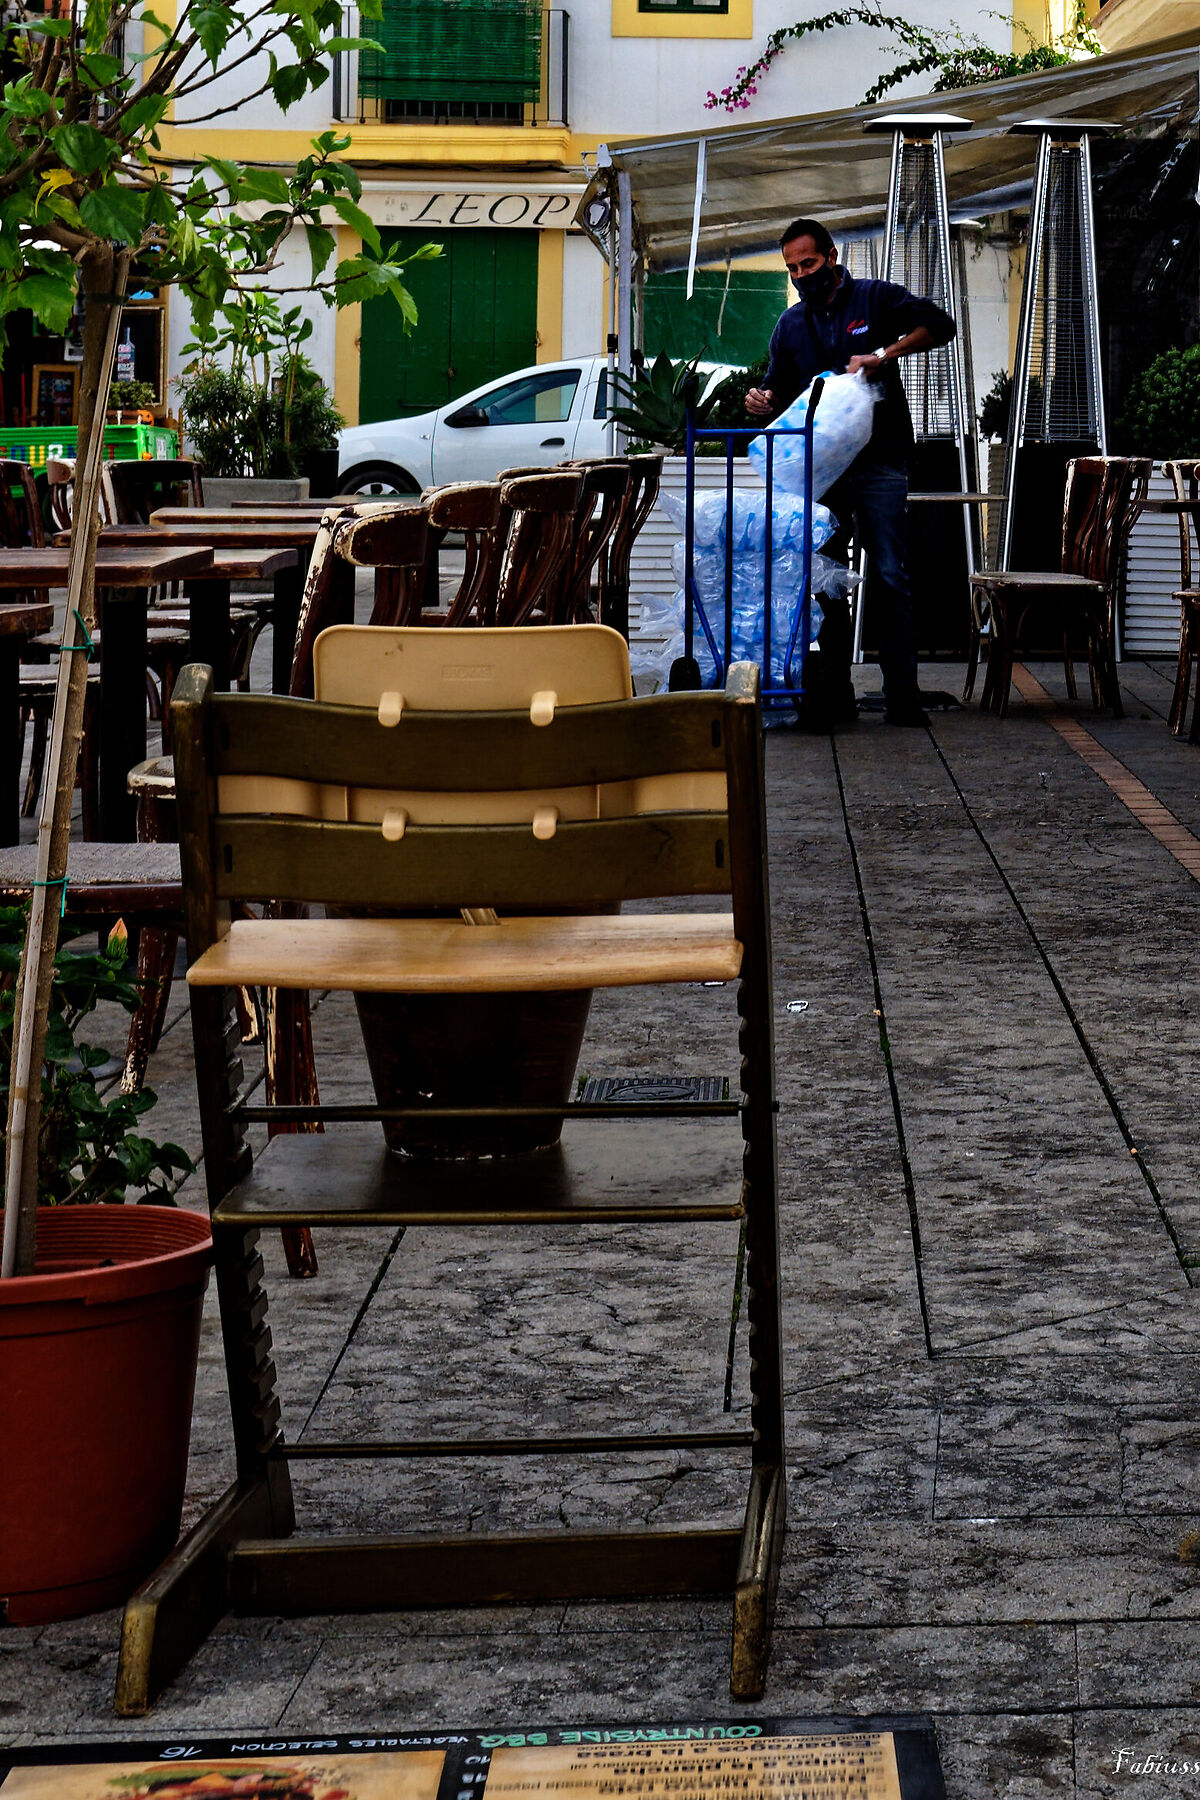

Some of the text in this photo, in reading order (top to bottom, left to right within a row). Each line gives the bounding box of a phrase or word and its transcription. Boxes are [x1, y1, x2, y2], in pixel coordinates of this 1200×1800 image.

[408, 193, 578, 226] LEOP
[475, 1724, 763, 1749] COUNTRYSIDE BBQ
[576, 1749, 652, 1758] brasa
[661, 1747, 684, 1756] la
